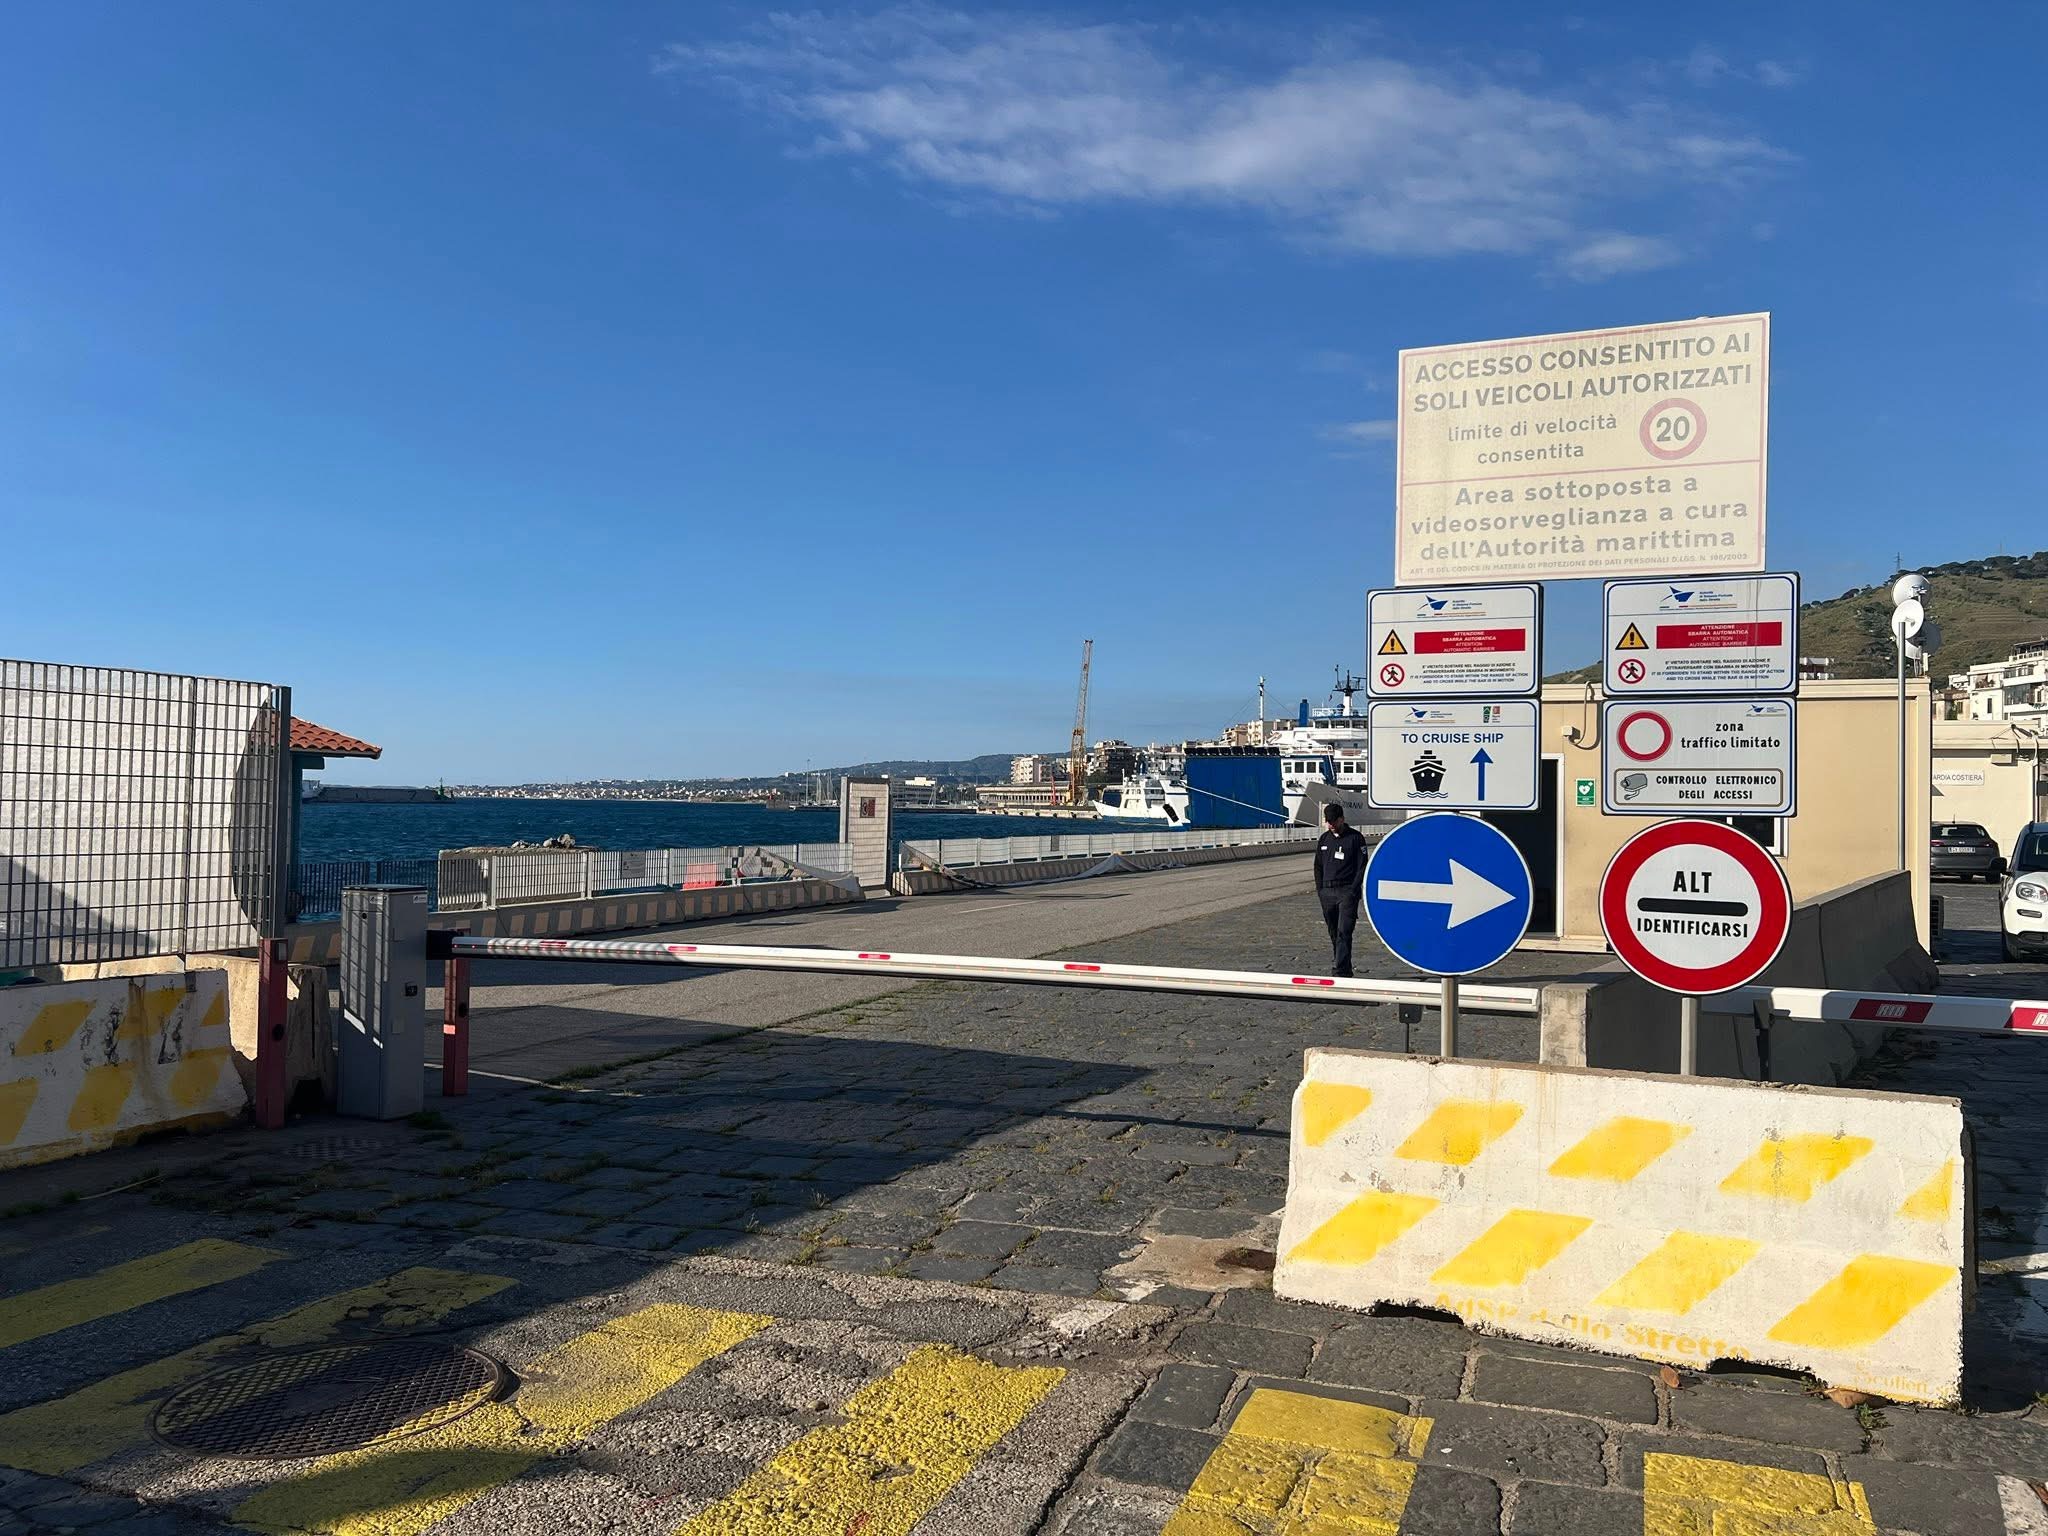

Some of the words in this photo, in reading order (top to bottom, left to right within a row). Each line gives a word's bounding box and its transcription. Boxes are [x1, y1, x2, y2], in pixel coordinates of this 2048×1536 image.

[1415, 354, 1532, 383] ACCESSO
[1540, 336, 1715, 371] CONSENTITO
[1723, 332, 1750, 354] AI
[1414, 390, 1467, 412] SOLI
[1476, 381, 1572, 406] VEICOLI
[1581, 364, 1751, 398] AUTORIZZATI
[1449, 424, 1502, 441] limite
[1510, 420, 1527, 437] di
[1535, 413, 1617, 434] velocità
[1656, 415, 1690, 442] 20
[1477, 442, 1584, 464] consentita
[1456, 487, 1514, 505] Area
[1525, 475, 1671, 501] sottoposta
[1683, 477, 1698, 491] a
[1411, 507, 1647, 535] videosorveglianza
[1659, 507, 1673, 521] a
[1685, 502, 1748, 520] cura
[1420, 535, 1584, 560] dell'Autorità
[1596, 530, 1735, 552] marittima
[1401, 733, 1418, 743] TO
[1422, 733, 1469, 743] CRUISE
[1473, 733, 1504, 743] SHIP
[1715, 723, 1744, 731] zona
[1681, 737, 1727, 748] traffico
[1730, 737, 1780, 748] limitato
[1656, 775, 1707, 784] CONTROLLO
[1715, 775, 1776, 784] ELETTRONICO
[1679, 790, 1704, 799] DEGLI
[1713, 790, 1752, 799] ACCESSI
[1673, 871, 1712, 893] ALT
[1637, 917, 1748, 937] IDENTIFICARSI
[1529, 1308, 1612, 1340] dllo
[1623, 1323, 1751, 1361] Stretto
